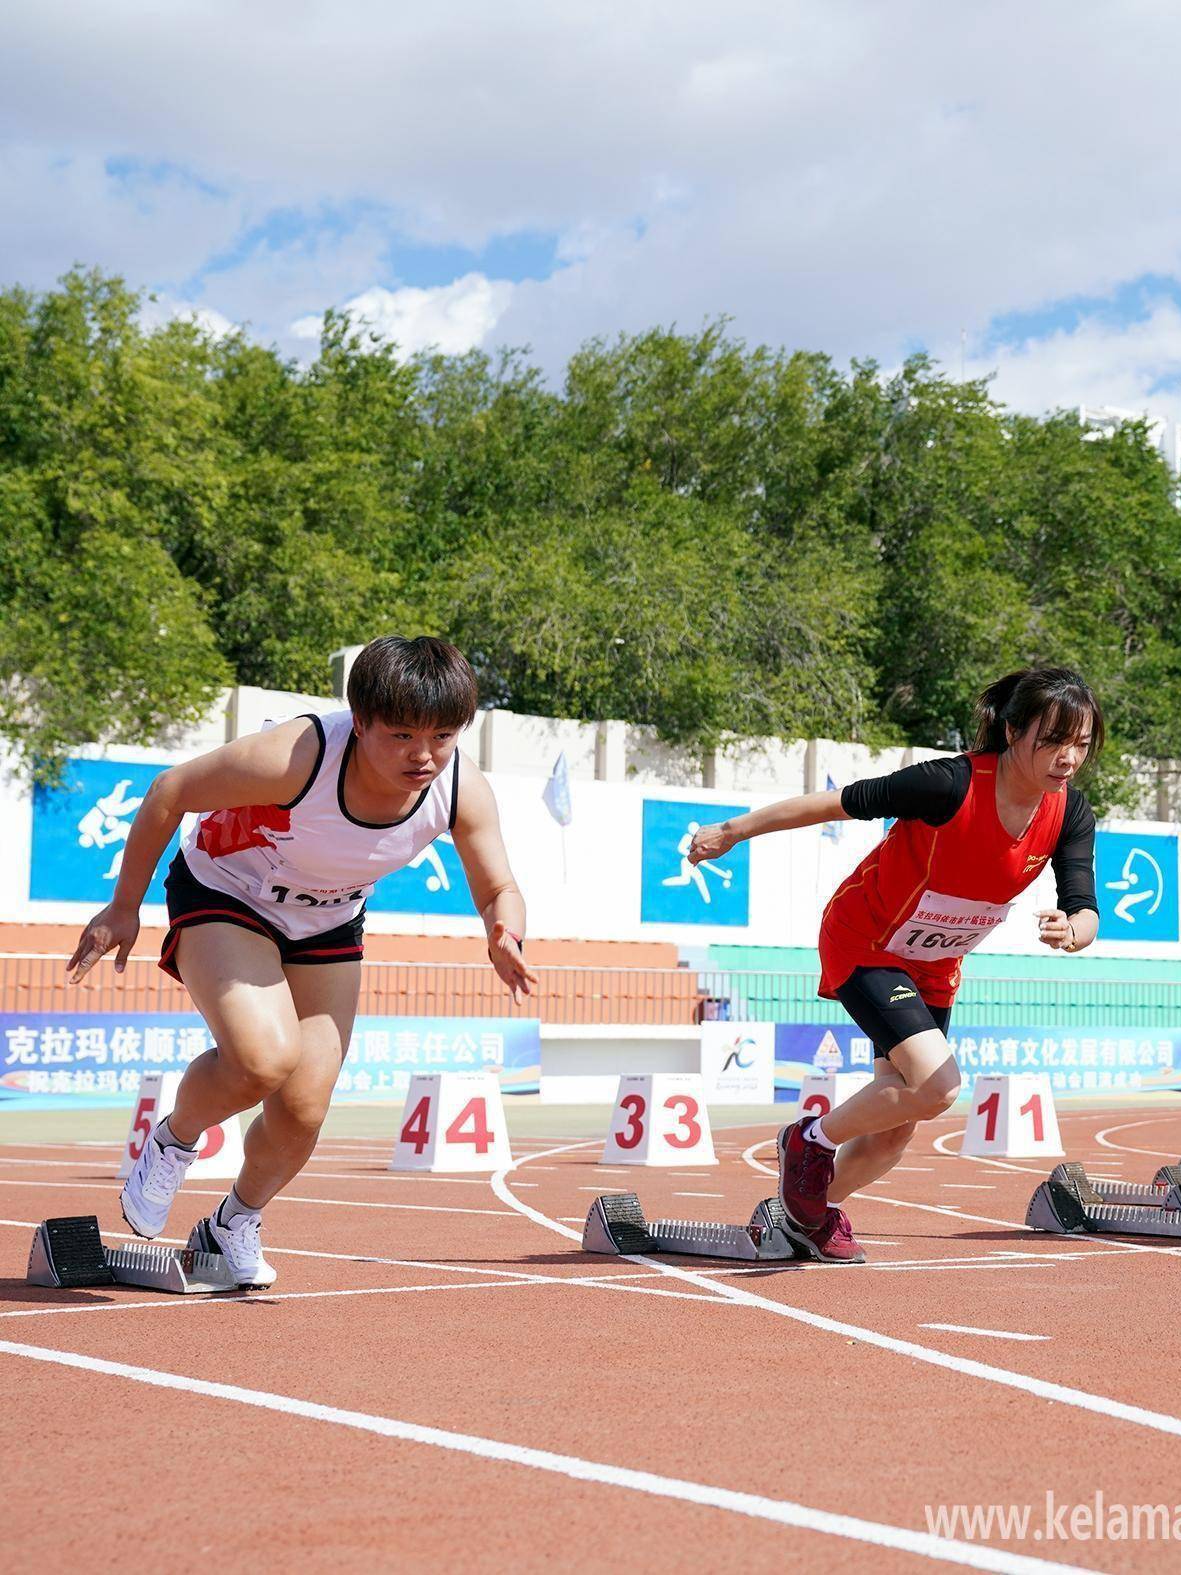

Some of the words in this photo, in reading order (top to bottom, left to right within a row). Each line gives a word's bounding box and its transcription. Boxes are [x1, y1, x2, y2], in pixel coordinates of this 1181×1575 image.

[905, 929, 980, 948] 1602
[129, 1098, 155, 1160] 5
[401, 1096, 431, 1154] 4
[445, 1097, 495, 1153] 4
[615, 1094, 646, 1149] 3
[663, 1095, 702, 1148] 3
[977, 1093, 1000, 1141] 1
[1020, 1094, 1044, 1141] 1
